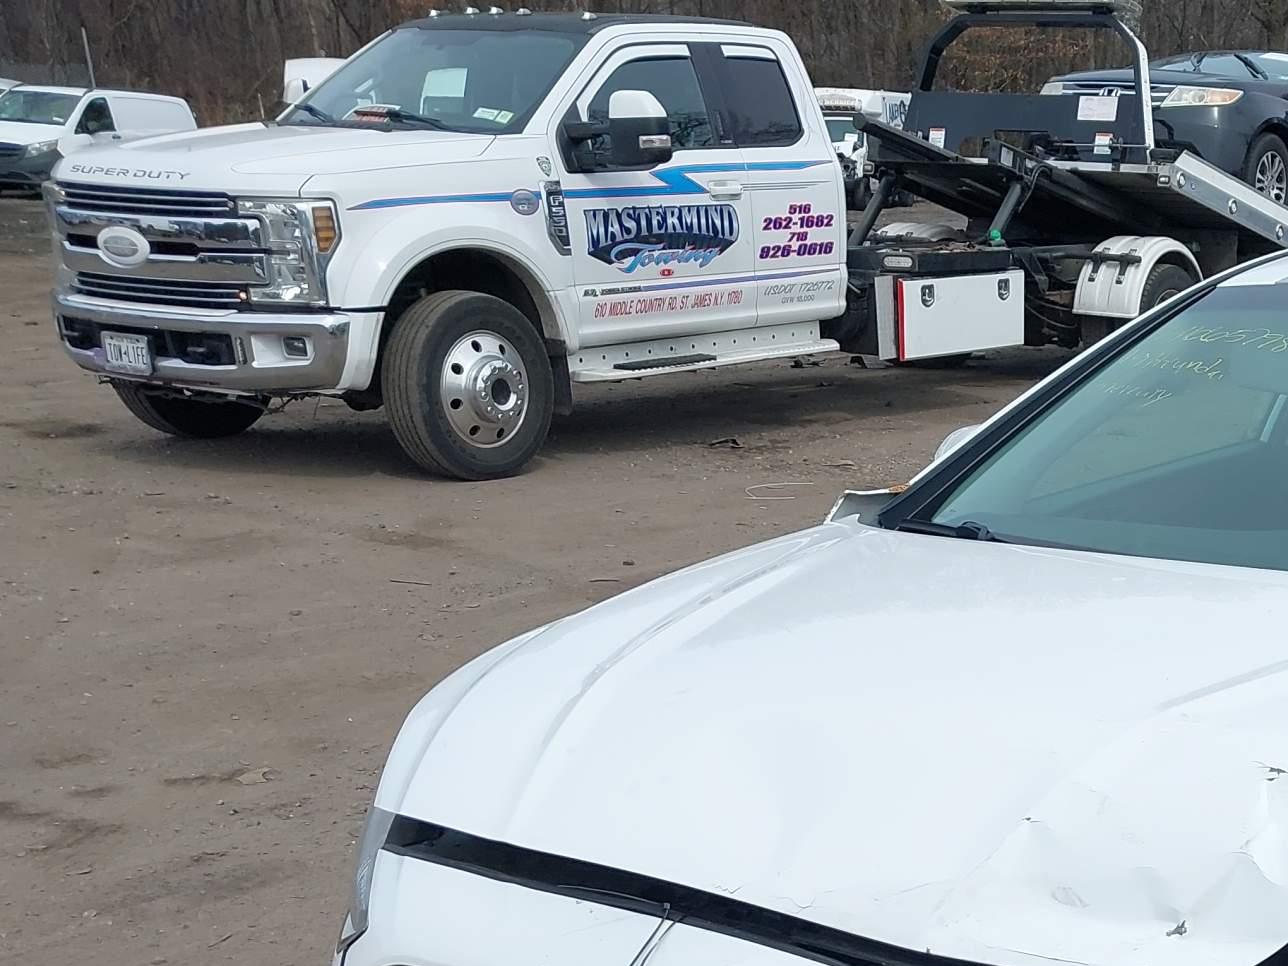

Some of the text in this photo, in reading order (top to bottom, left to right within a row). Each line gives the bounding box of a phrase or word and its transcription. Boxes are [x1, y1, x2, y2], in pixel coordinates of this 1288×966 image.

[70, 164, 191, 180] SUPER DUTY
[787, 203, 812, 216] 516
[584, 203, 740, 251] MASTERMIND
[762, 214, 834, 231] 262-1682
[786, 231, 809, 243] 718
[610, 242, 722, 274] Towing
[608, 300, 634, 317] MIDDLE
[635, 296, 667, 314] COUNTRY
[691, 292, 712, 309] JAMES
